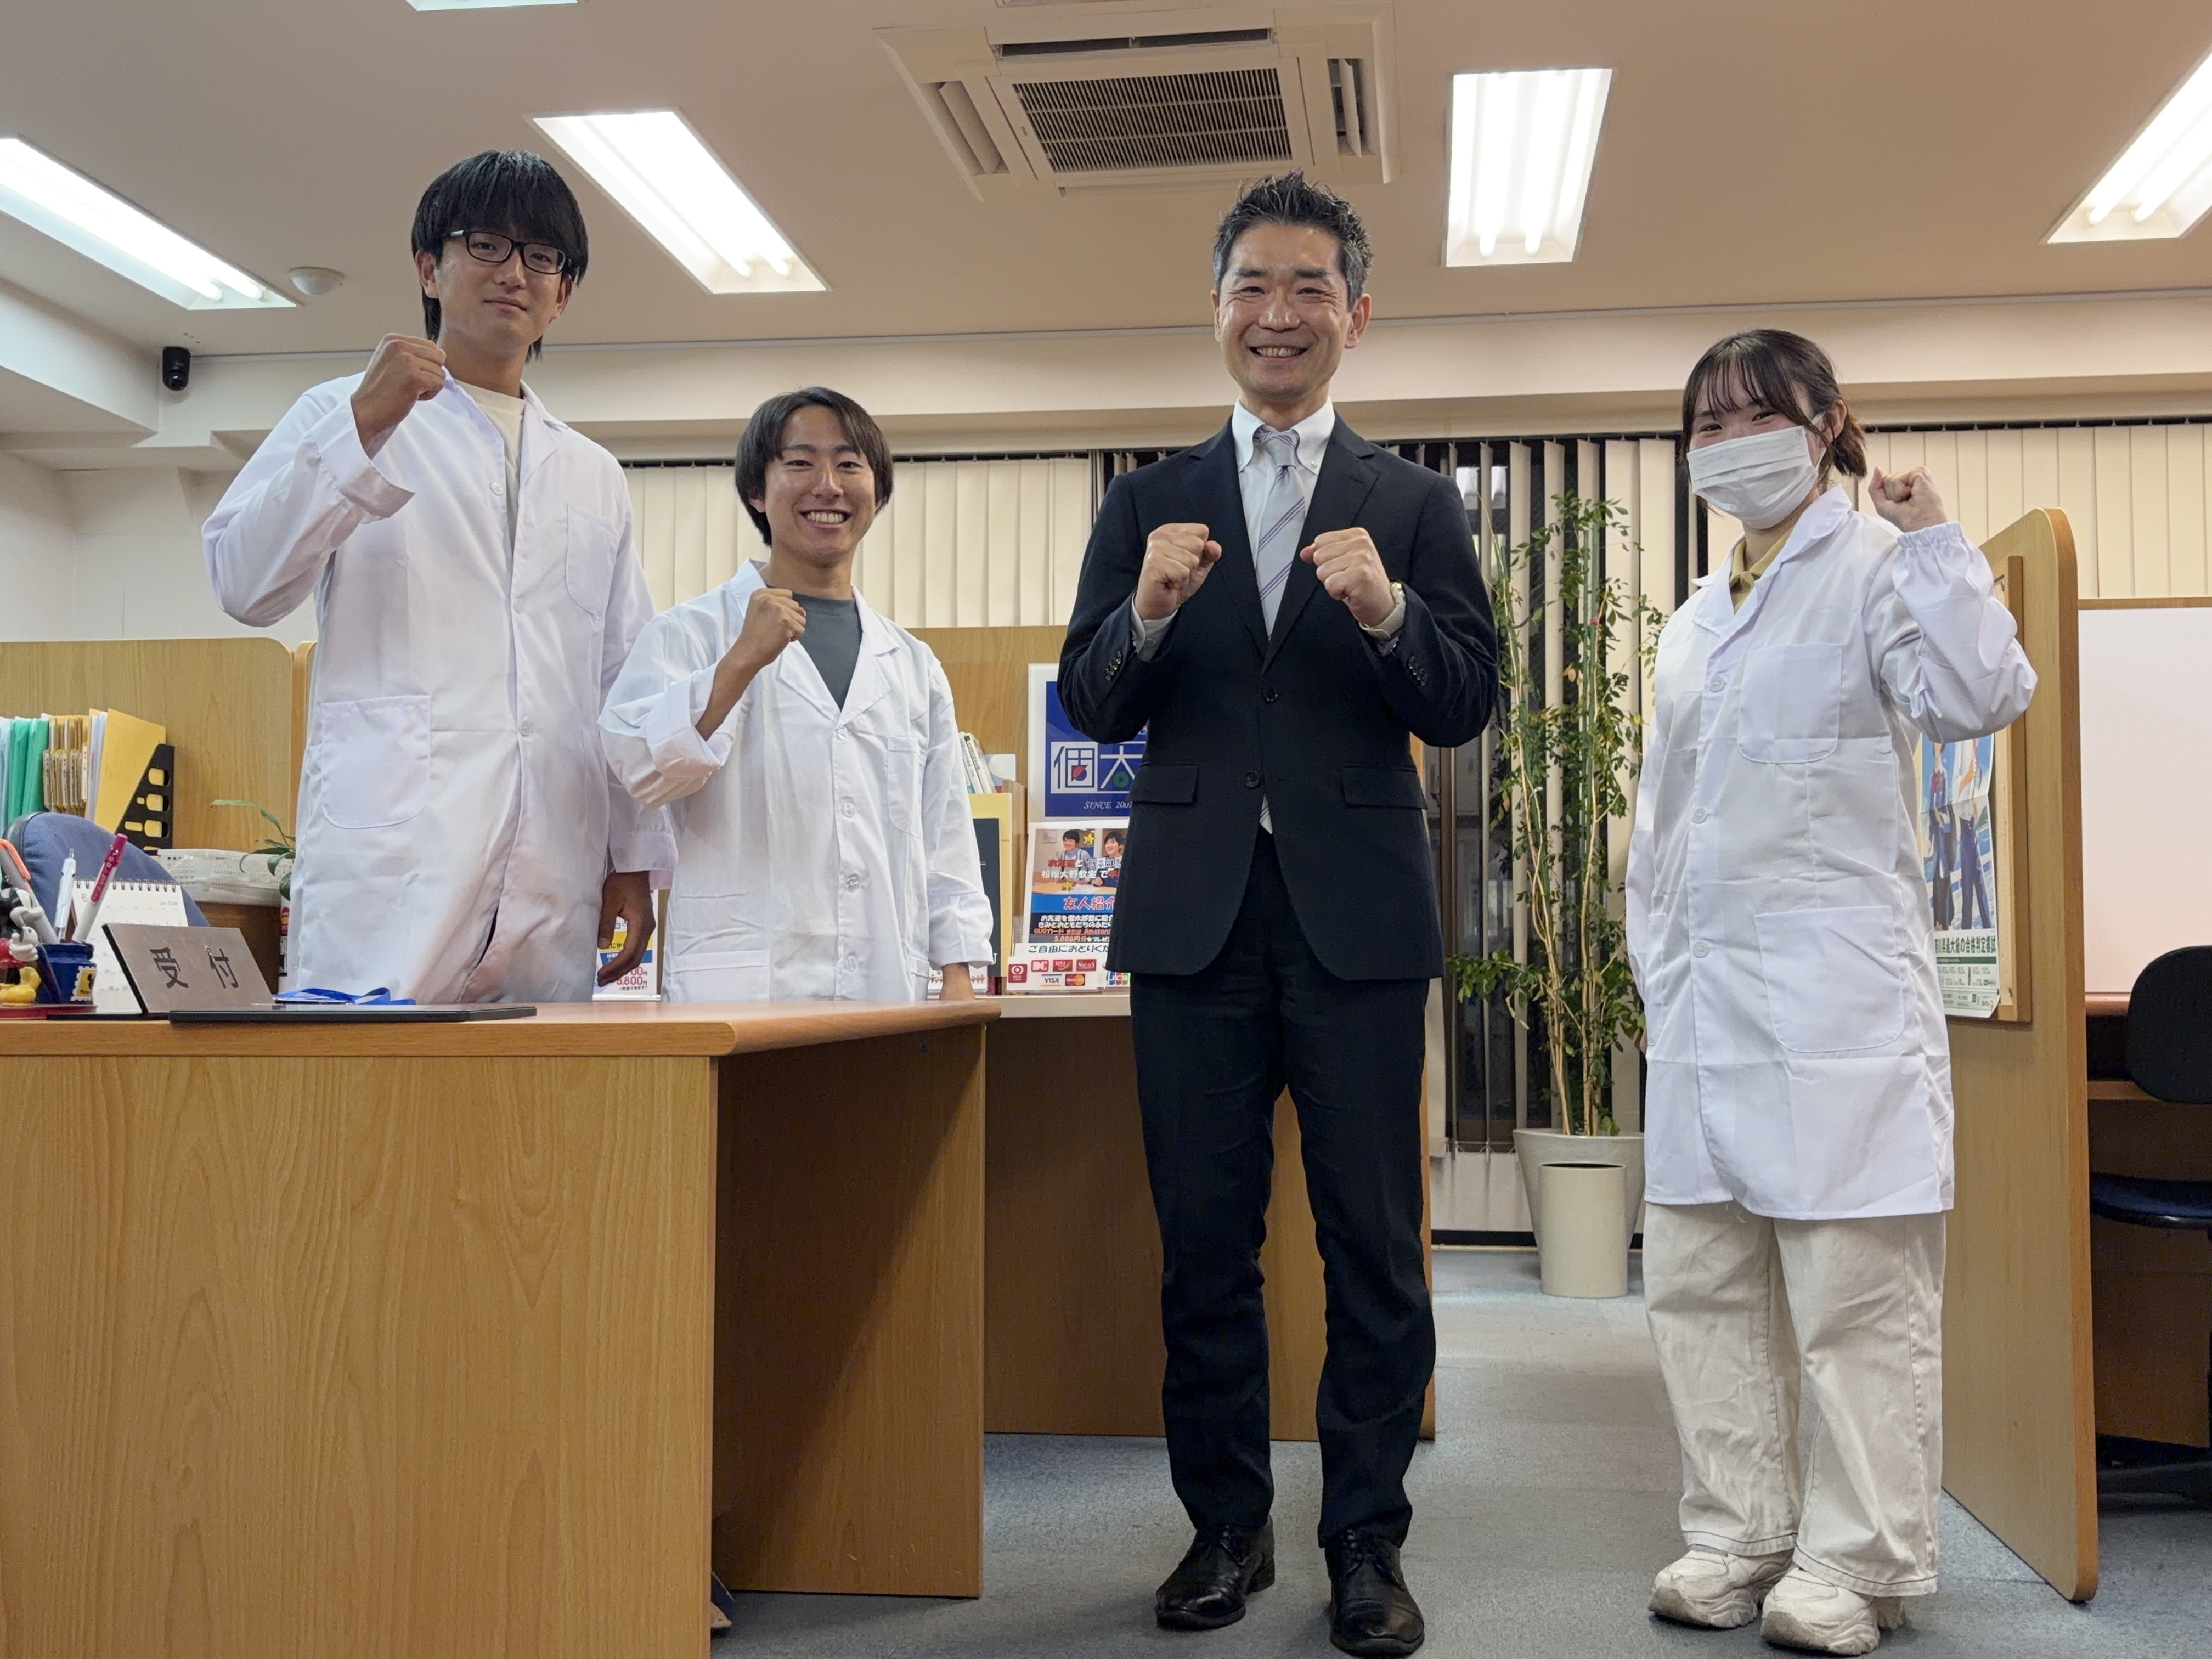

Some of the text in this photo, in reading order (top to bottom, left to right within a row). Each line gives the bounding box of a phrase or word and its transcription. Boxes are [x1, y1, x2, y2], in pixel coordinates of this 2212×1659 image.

[1084, 801, 1111, 809] SINCE
[1041, 870, 1096, 878] 相模大野教室
[82, 893, 88, 902] 6
[150, 947, 239, 988] 受付
[1033, 961, 1047, 970] DC
